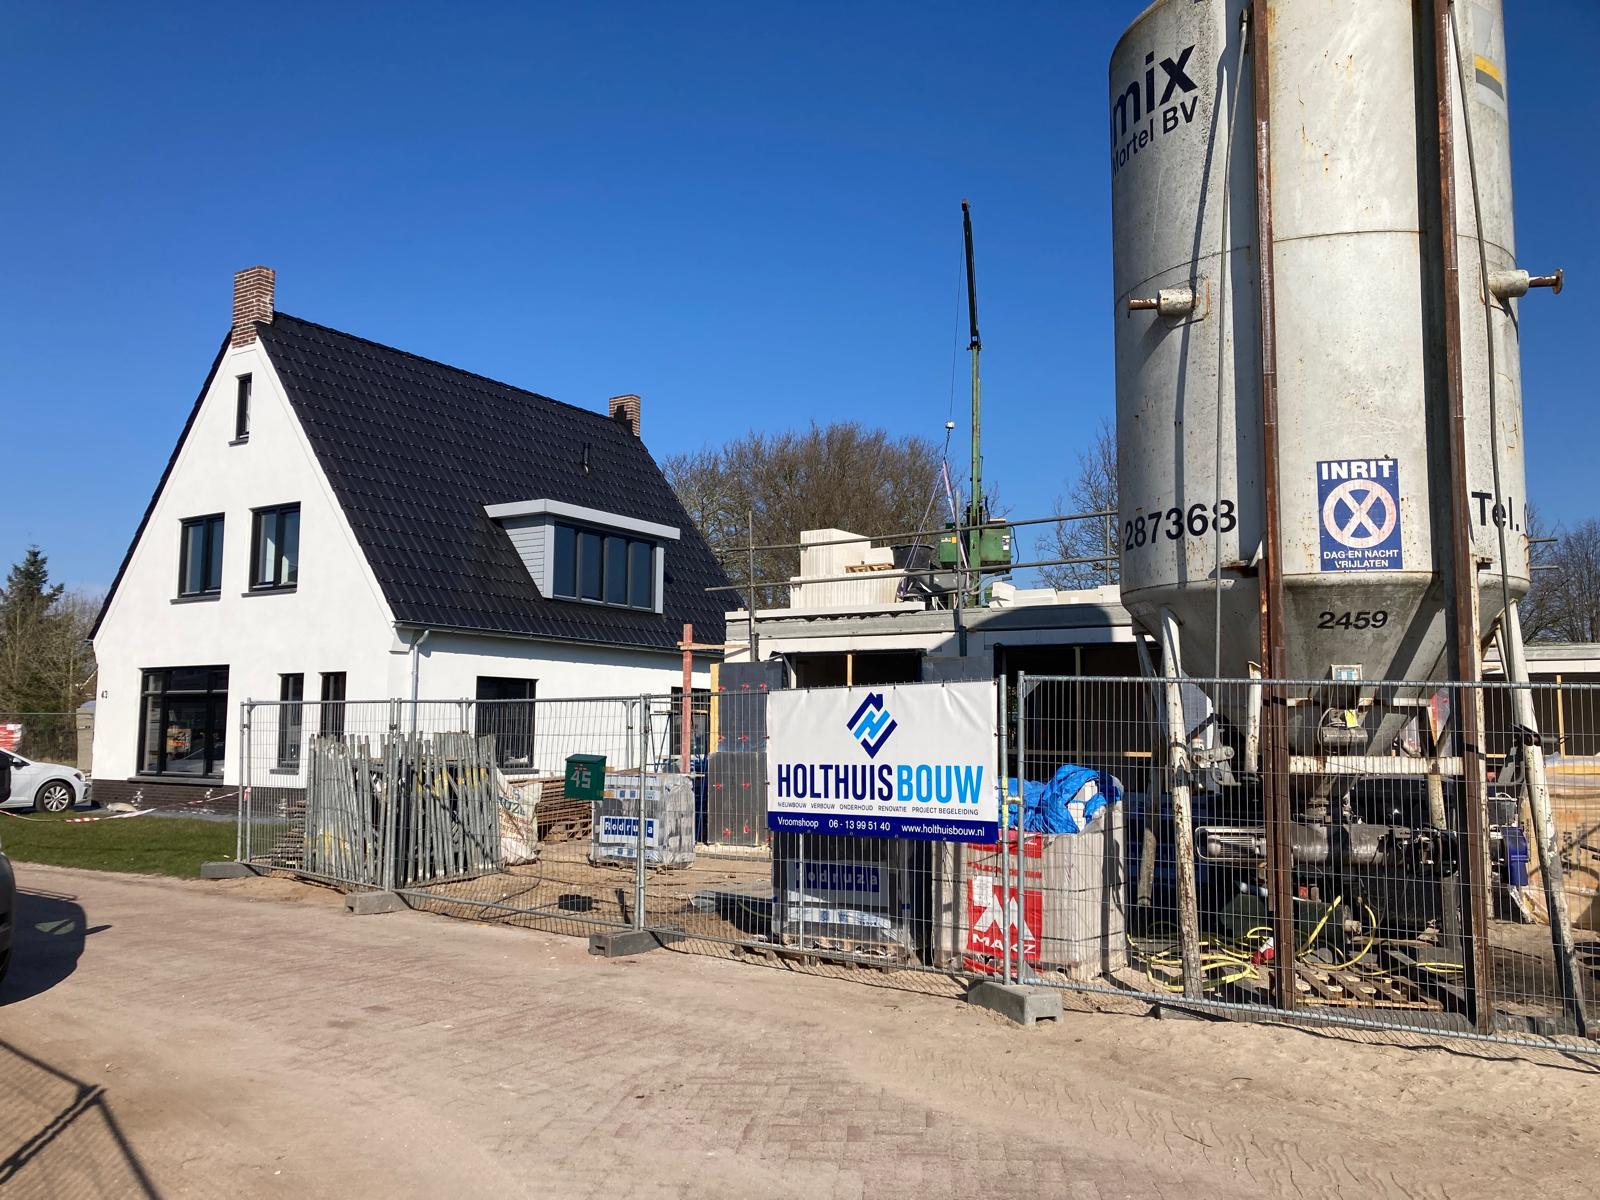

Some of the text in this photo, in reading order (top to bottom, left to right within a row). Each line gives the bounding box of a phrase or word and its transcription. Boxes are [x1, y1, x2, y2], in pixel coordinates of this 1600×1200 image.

[1163, 96, 1198, 135] BV
[1321, 461, 1394, 480] INRIT
[1471, 491, 1519, 532] Tel.
[1125, 499, 1237, 551] 287368
[1323, 549, 1399, 559] DAG EN NACHT
[1334, 559, 1389, 569] VRIJLATEN
[1317, 610, 1388, 630] 2459
[570, 770, 592, 789] 45
[912, 806, 937, 814] PROJECT
[938, 807, 979, 815] BEGELEIDING
[604, 821, 653, 834] Rodrua
[777, 816, 819, 829] Vroomshoop
[828, 819, 839, 828] 06
[845, 820, 855, 829] 13
[856, 820, 866, 830] 99
[868, 821, 877, 830] 51
[880, 821, 890, 831] 40
[901, 823, 985, 837] www.holthuisbouw.nl
